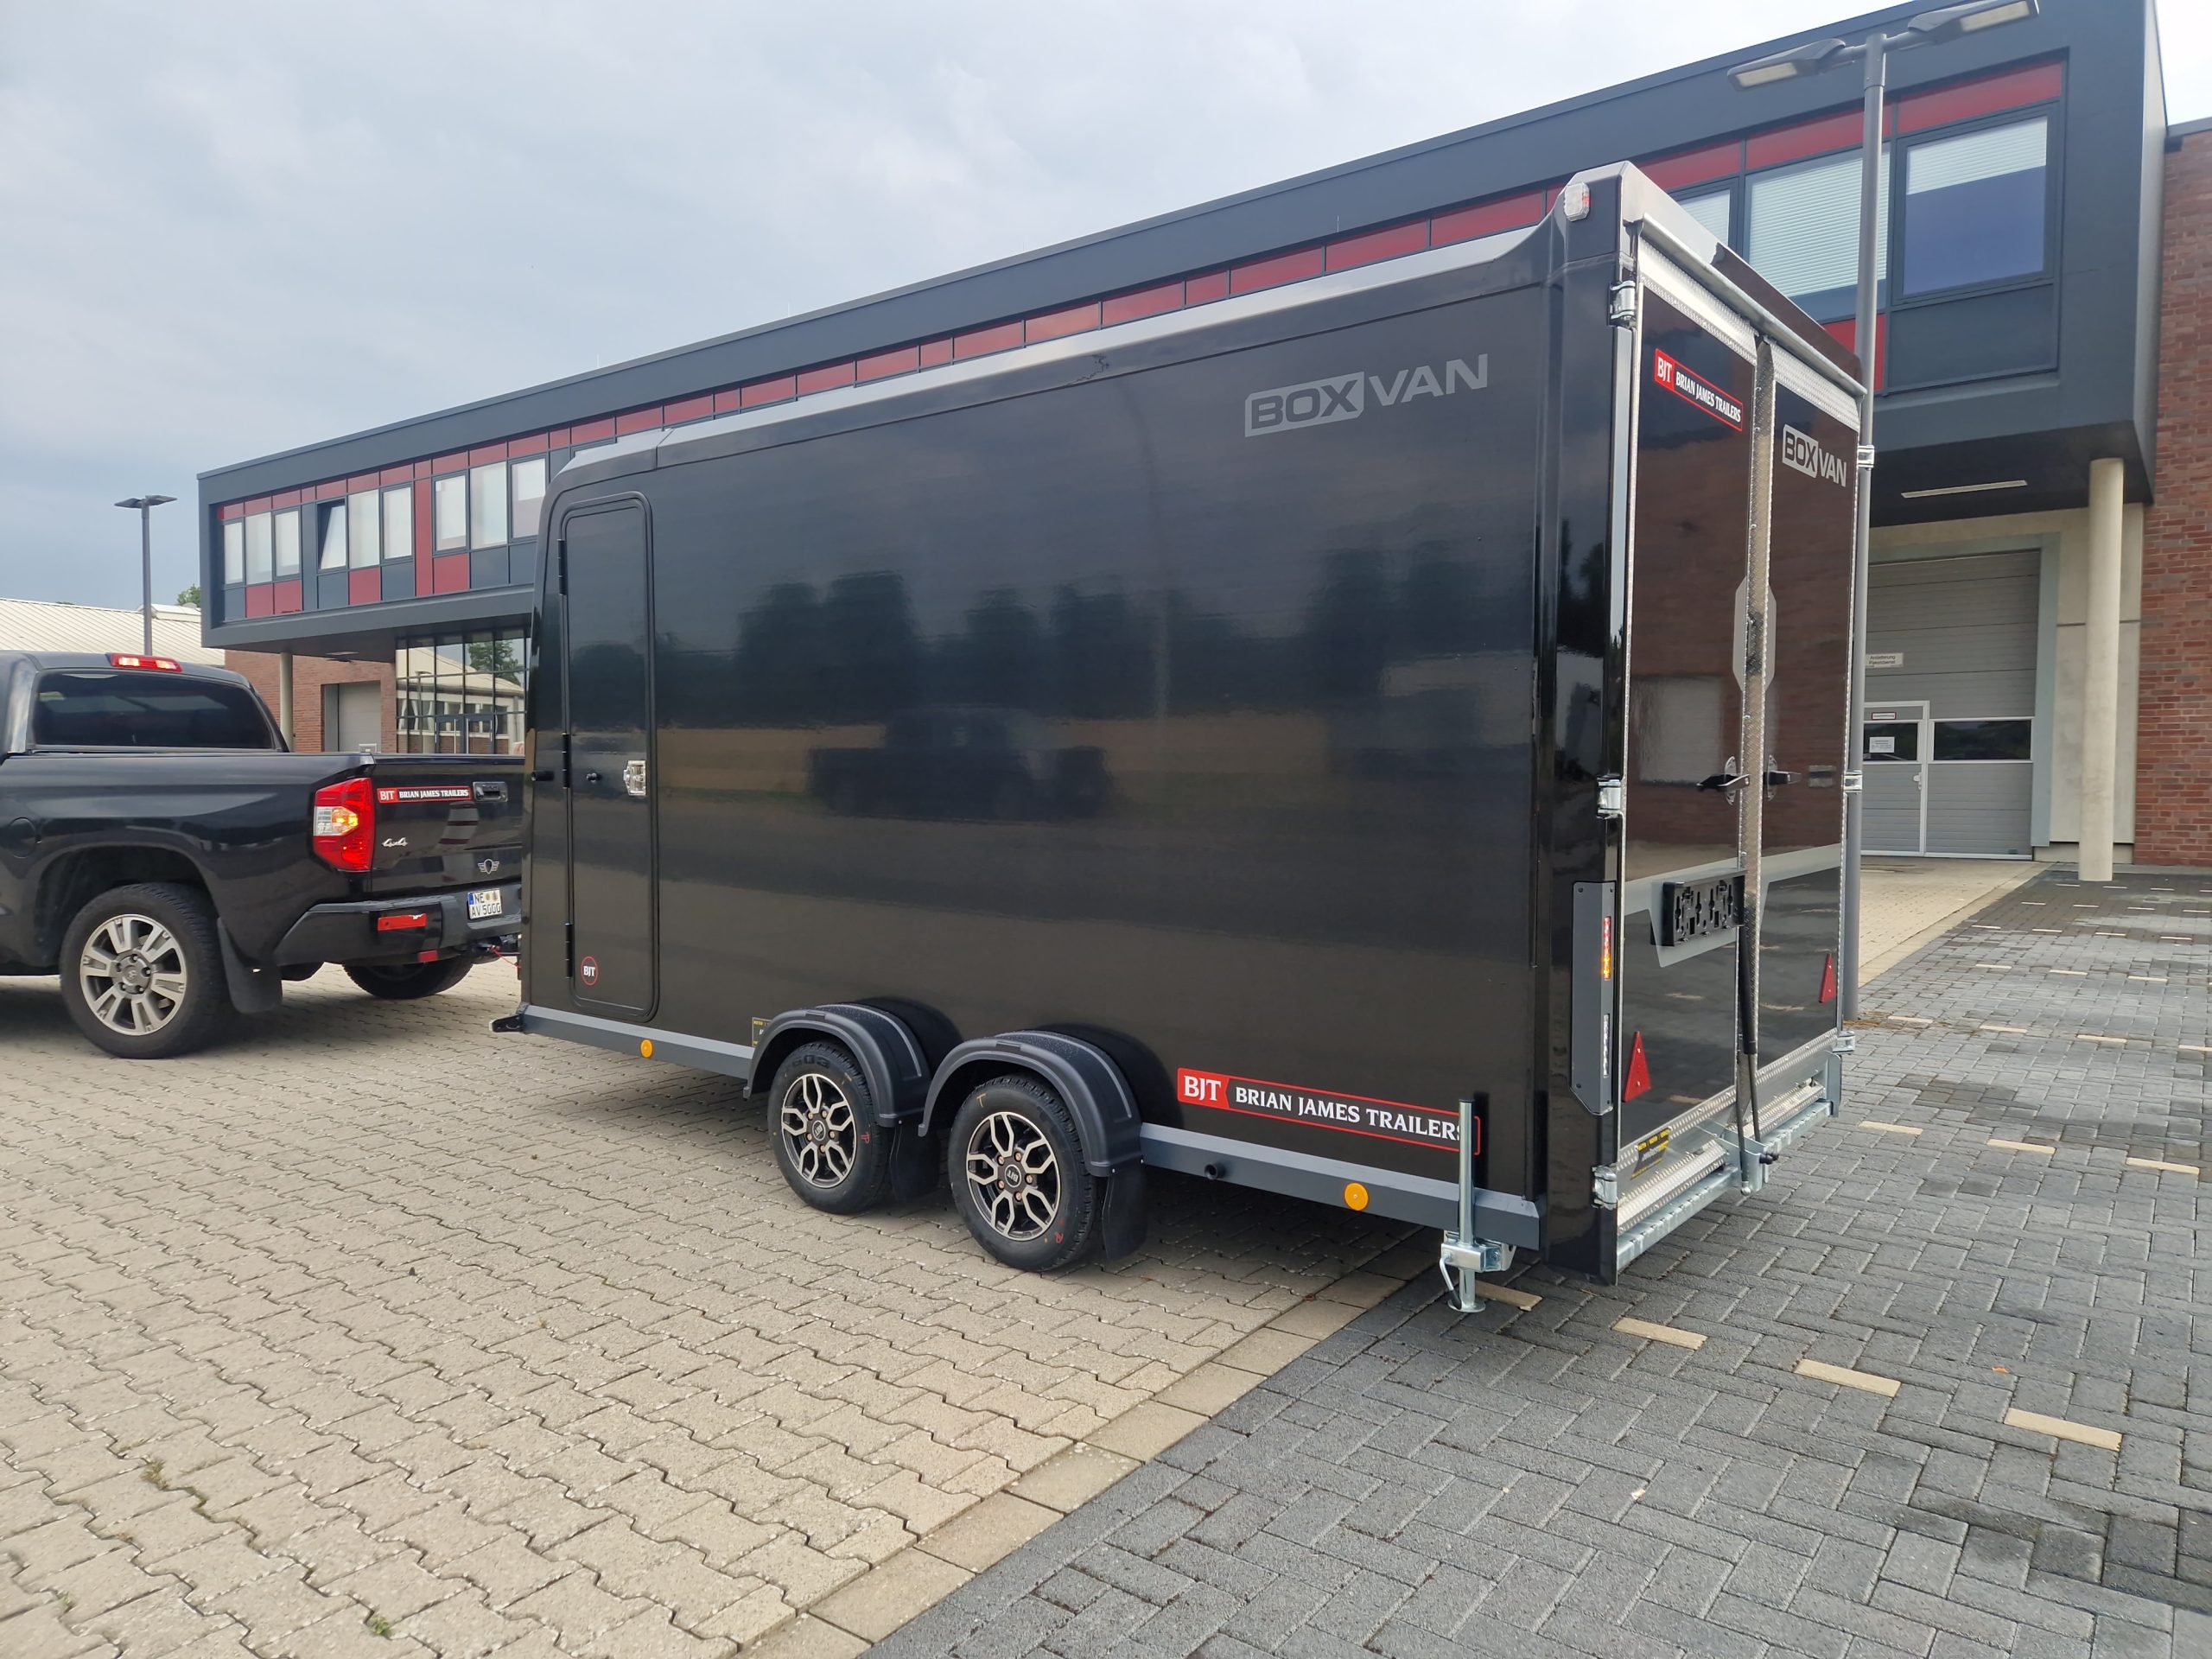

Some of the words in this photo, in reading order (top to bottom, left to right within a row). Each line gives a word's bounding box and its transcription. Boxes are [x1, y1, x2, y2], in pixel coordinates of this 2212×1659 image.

[1657, 356, 1673, 383] BJT
[1675, 371, 1696, 396] BRIAN
[1695, 383, 1715, 407] JAMES
[1715, 396, 1741, 423] TRAILERS
[380, 790, 395, 801] BJT
[420, 790, 440, 799] JAMES
[474, 893, 485, 905] NE
[583, 965, 595, 976] BJT
[1184, 1075, 1222, 1102] BJT
[1235, 1086, 1293, 1112] BRIAN
[1298, 1096, 1361, 1123] JAMES
[1365, 1109, 1460, 1141] TRAILER
